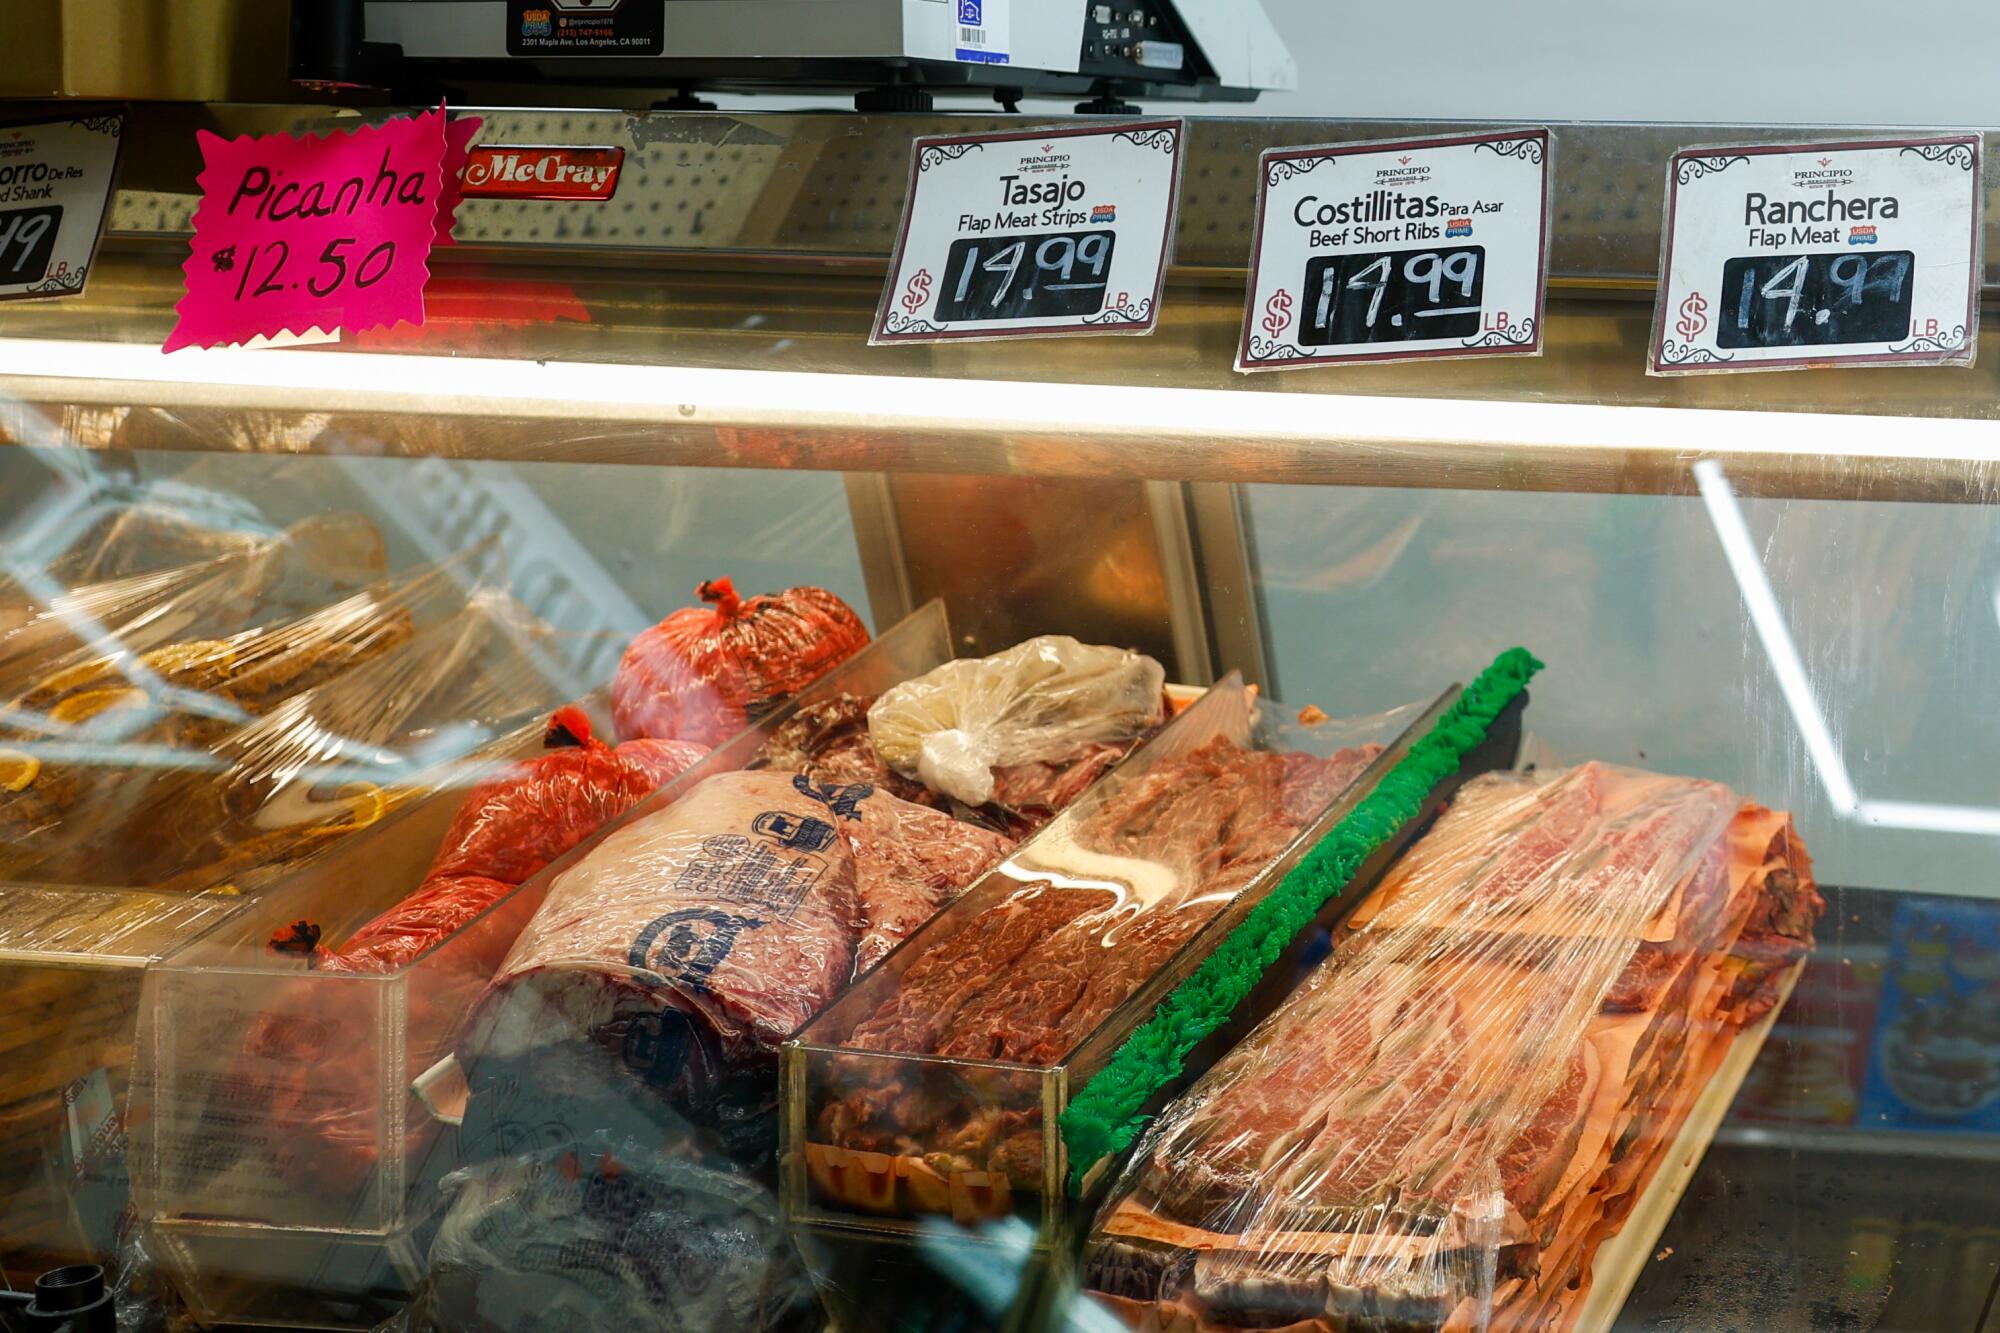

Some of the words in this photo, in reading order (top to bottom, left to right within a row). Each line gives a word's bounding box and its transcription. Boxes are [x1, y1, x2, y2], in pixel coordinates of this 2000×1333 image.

[522, 38, 538, 46] 2301
[539, 38, 559, 47] Maple
[560, 38, 574, 46] Ave.
[575, 38, 588, 46] Los
[620, 37, 631, 46] CA
[631, 37, 650, 46] 90011
[1020, 154, 1071, 165] PRINCIPIO
[48, 168, 64, 181] De
[65, 166, 83, 179] Res
[227, 146, 426, 222] Picanha
[466, 154, 617, 191] McCray
[1376, 166, 1431, 178] PRINCIPIO
[1794, 169, 1853, 179] PRINCIPIO
[11, 184, 54, 202] Shank
[1000, 174, 1085, 211] Tasajo
[1294, 190, 1440, 227] Costillitas
[1440, 202, 1469, 217] Para
[1472, 200, 1504, 214] Asar
[1745, 190, 1899, 226] Ranchera
[958, 213, 992, 234] Flap
[994, 210, 1037, 230] Meat
[1042, 207, 1087, 228] Strips
[1449, 219, 1470, 228] USDA
[1852, 227, 1874, 235] USDA
[1309, 227, 1350, 248] Beef
[1353, 225, 1401, 244] Short
[1405, 222, 1440, 240] Ribs
[1749, 228, 1786, 249] Flap
[1791, 226, 1840, 245] Meat
[46, 261, 68, 279] LB
[902, 269, 932, 314] $
[954, 234, 1110, 307] 14.99
[1104, 292, 1128, 310] LB
[1262, 289, 1293, 338] $
[1315, 251, 1480, 329] 14.99
[1484, 311, 1509, 331] LB
[1676, 292, 1708, 342] $
[1912, 318, 1938, 338] LB
